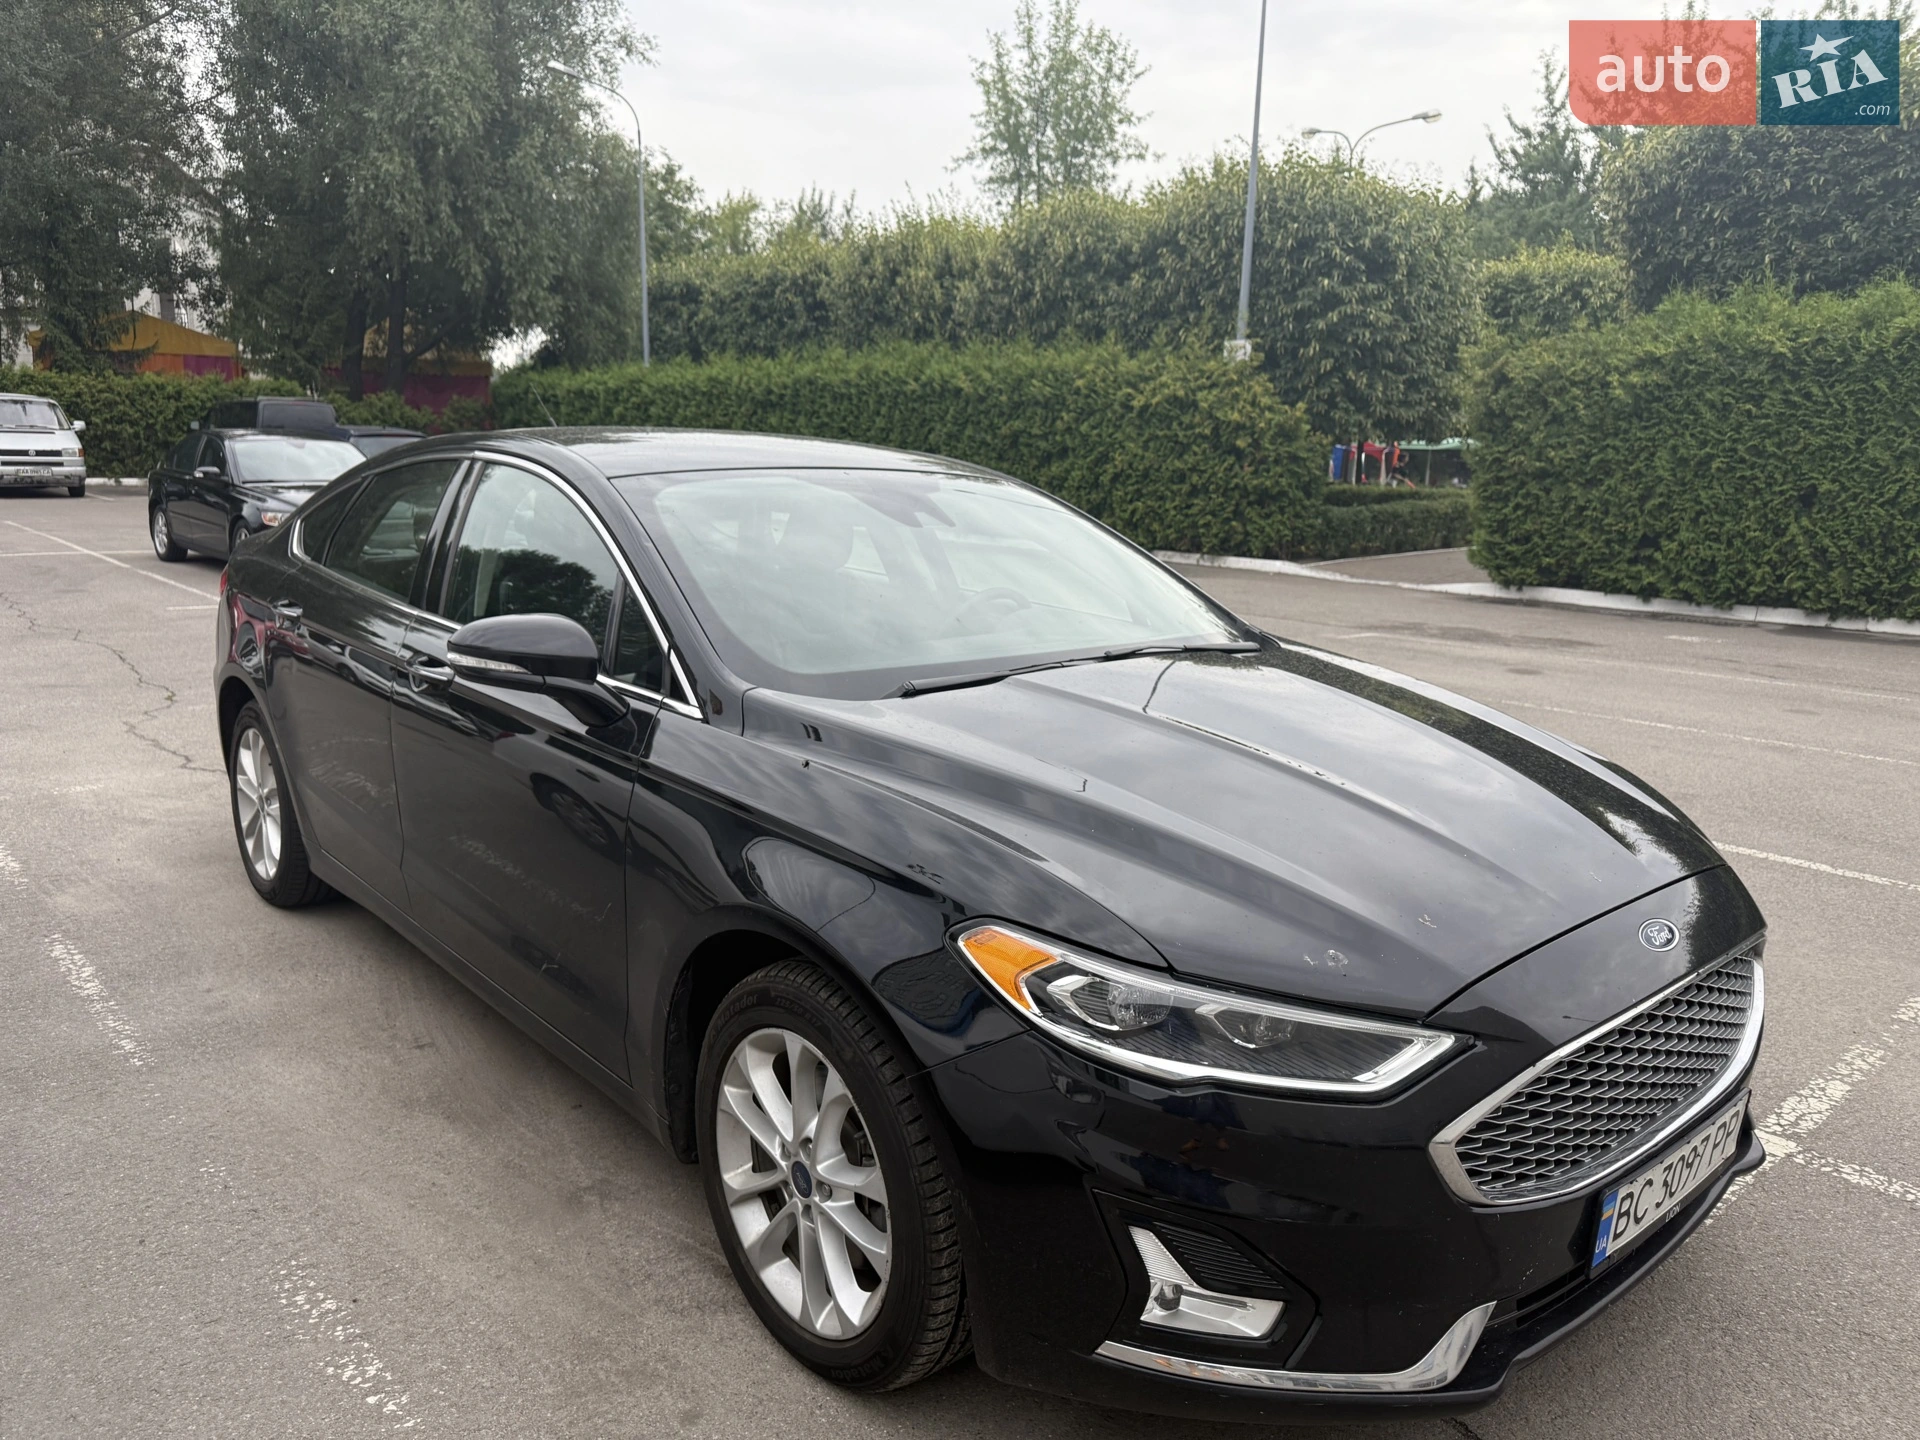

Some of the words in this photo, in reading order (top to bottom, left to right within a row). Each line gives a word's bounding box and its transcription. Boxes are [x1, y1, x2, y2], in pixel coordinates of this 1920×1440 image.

[1647, 926, 1672, 945] Ford
[716, 993, 759, 1031] Matador
[1611, 1178, 1654, 1243] BC
[1655, 1132, 1712, 1209] 3097
[1708, 1109, 1740, 1167] PP
[1595, 1235, 1607, 1253] UA
[831, 1353, 885, 1382] Matador
